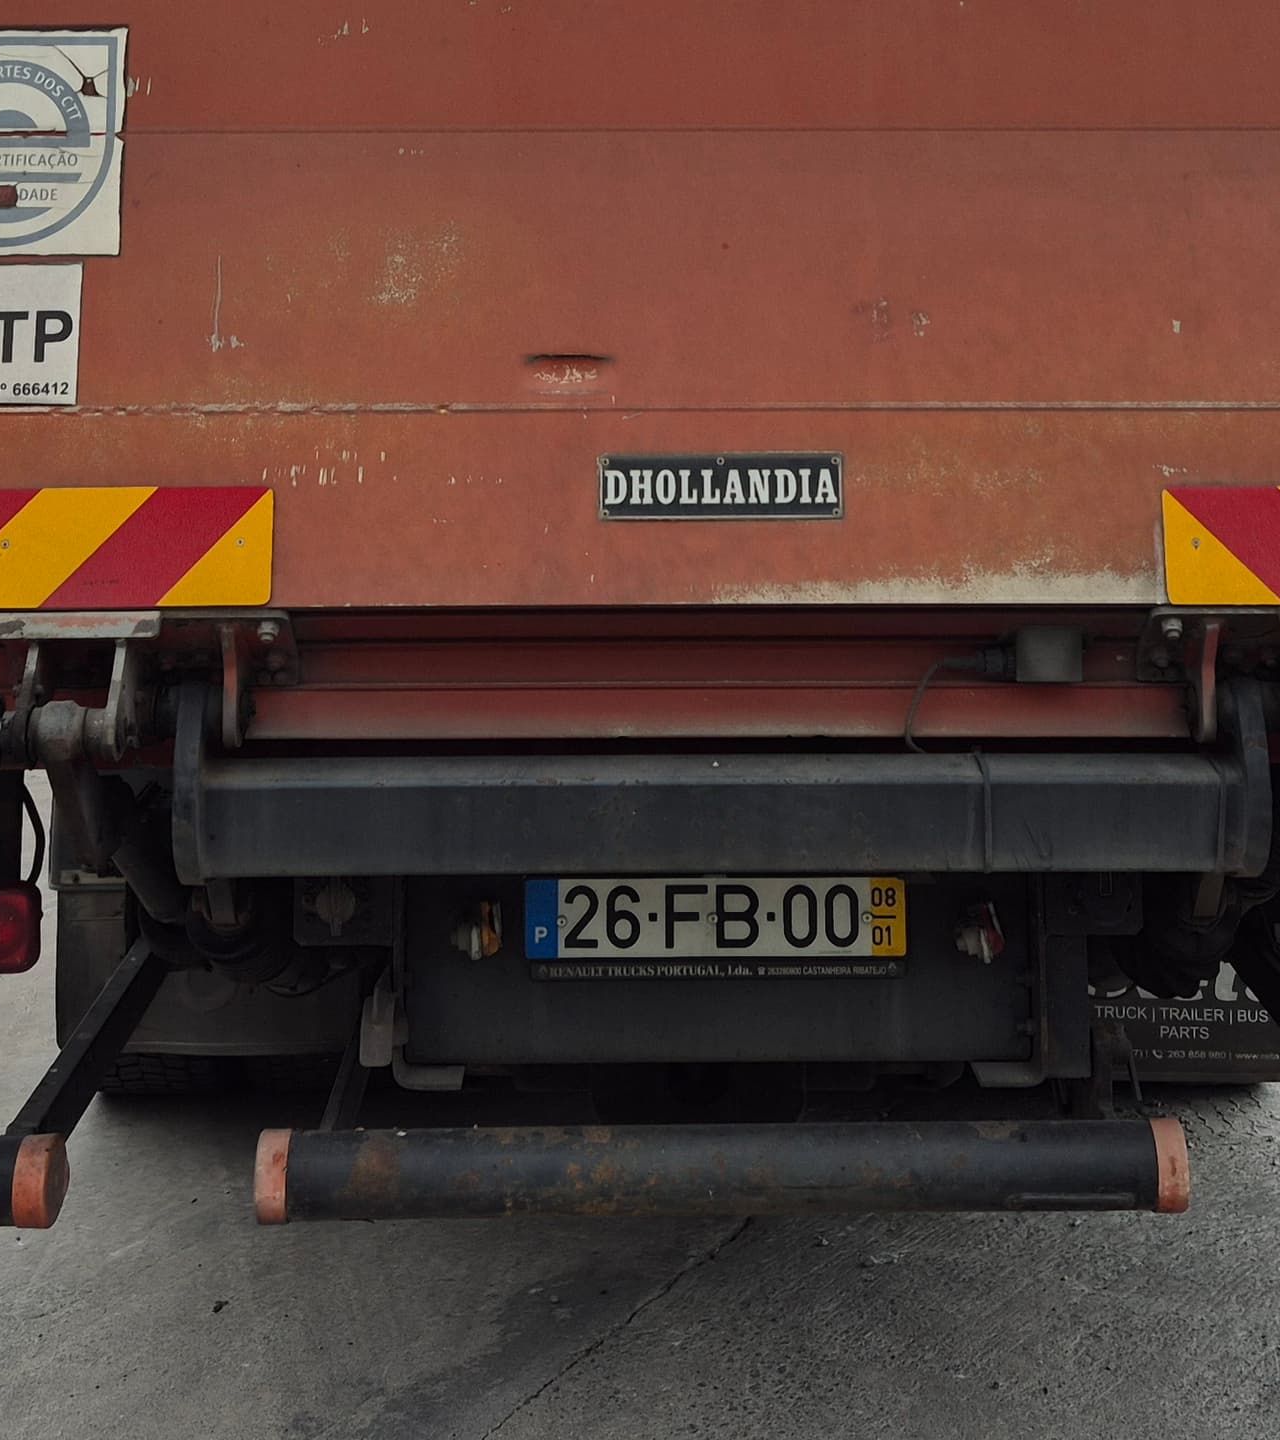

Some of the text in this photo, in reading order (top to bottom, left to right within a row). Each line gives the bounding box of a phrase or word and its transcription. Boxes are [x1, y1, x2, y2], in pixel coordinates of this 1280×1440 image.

[34, 71, 65, 97] DOS
[60, 96, 82, 120] CTT
[12, 382, 69, 397] 666412
[604, 468, 838, 505] DHOLLANDIA
[871, 887, 896, 907] 08
[534, 926, 548, 944] P
[872, 925, 892, 946] 01
[549, 964, 604, 977] RENAULT
[608, 964, 655, 977] TRUCKS
[803, 966, 852, 975] CASTANHEIRA
[853, 965, 887, 975] RIBATEJO
[1094, 1005, 1147, 1020] TRUCK
[1160, 1007, 1224, 1023] TRAILER
[1237, 1009, 1269, 1023] BUS
[1160, 1025, 1210, 1040] PARTS
